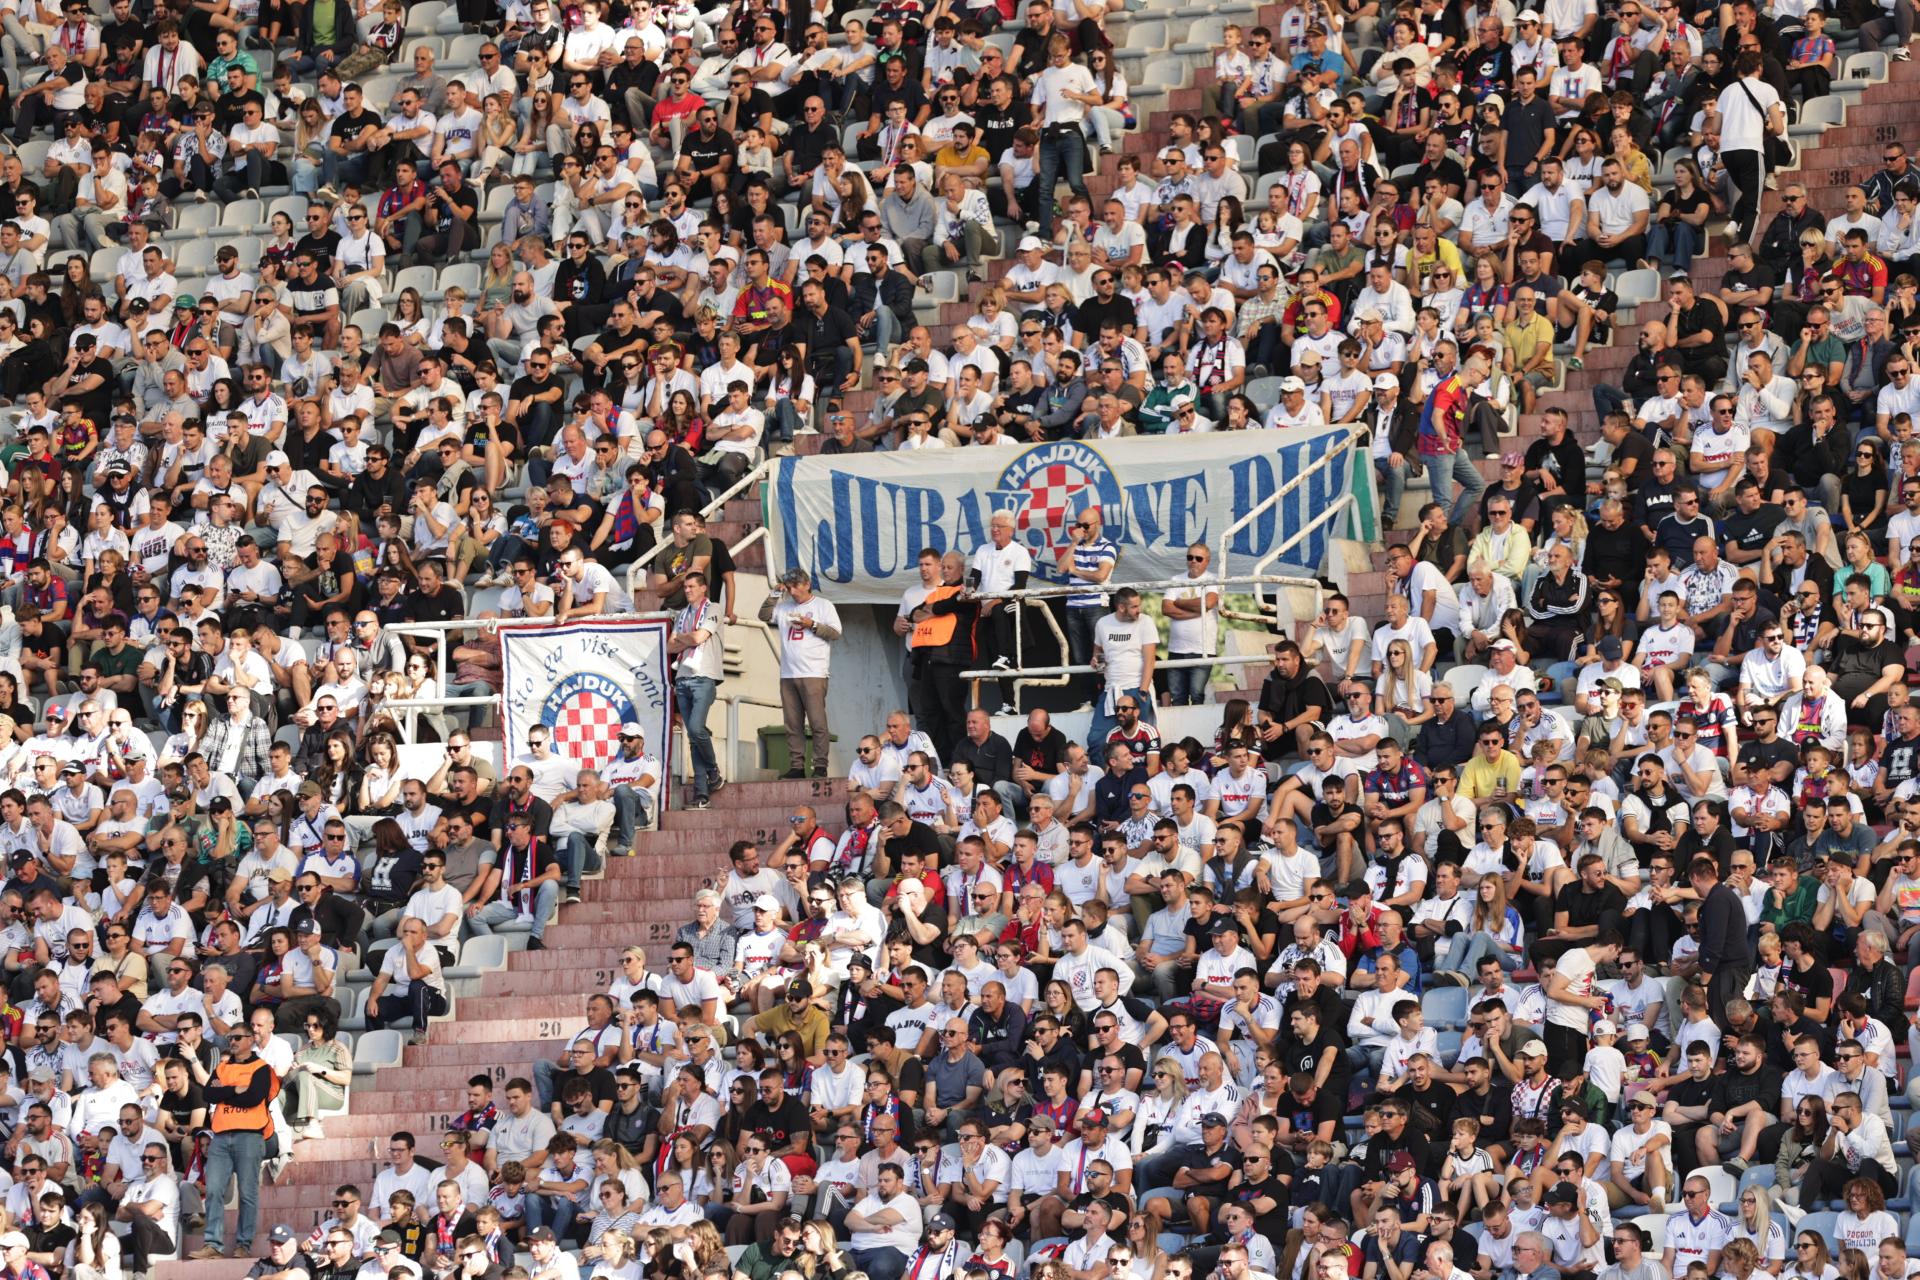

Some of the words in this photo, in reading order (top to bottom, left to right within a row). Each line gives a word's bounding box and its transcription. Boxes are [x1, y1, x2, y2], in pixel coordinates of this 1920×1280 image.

[1876, 125, 1897, 143] 39
[691, 150, 718, 159] Champion
[1830, 169, 1850, 186] 38
[1704, 452, 1731, 461] TOMMY
[1005, 444, 1108, 489] HAJDUK
[1118, 469, 1208, 548] NE
[1108, 633, 1131, 642] PUMA
[543, 645, 563, 683] ga
[581, 634, 619, 660] više
[629, 661, 664, 709] lome
[548, 675, 628, 713] HAJDUK
[611, 776, 637, 785] TOMMY
[811, 780, 832, 797] 25
[1222, 794, 1249, 802] TOMMY
[757, 829, 778, 846] 24
[650, 923, 671, 940] 22
[595, 970, 615, 986] 21
[1208, 975, 1232, 983] TOMMY
[540, 1021, 561, 1037] 20
[487, 1065, 506, 1083] 19
[430, 1113, 450, 1131] 18
